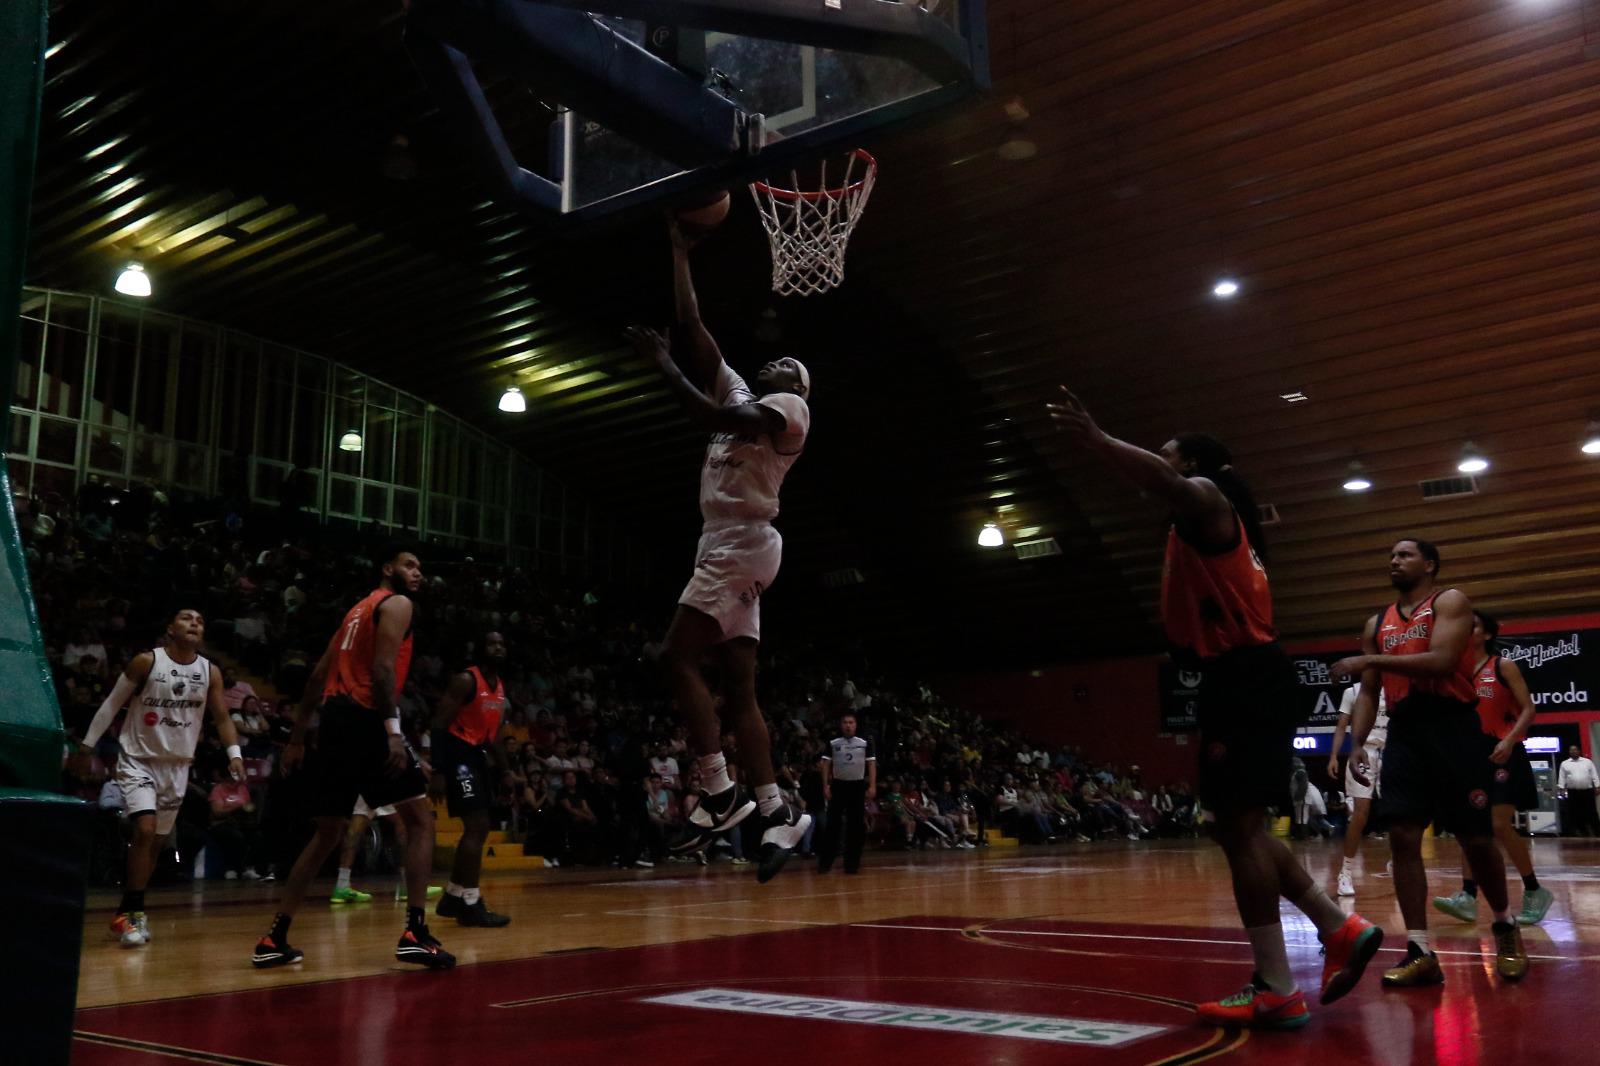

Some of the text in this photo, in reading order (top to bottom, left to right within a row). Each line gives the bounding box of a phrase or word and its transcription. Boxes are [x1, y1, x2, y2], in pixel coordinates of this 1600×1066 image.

[1525, 633, 1580, 669] Huichol
[1529, 681, 1588, 705] uroda
[1307, 713, 1340, 721] ANTART
[1293, 736, 1317, 749] on
[461, 780, 472, 793] 15
